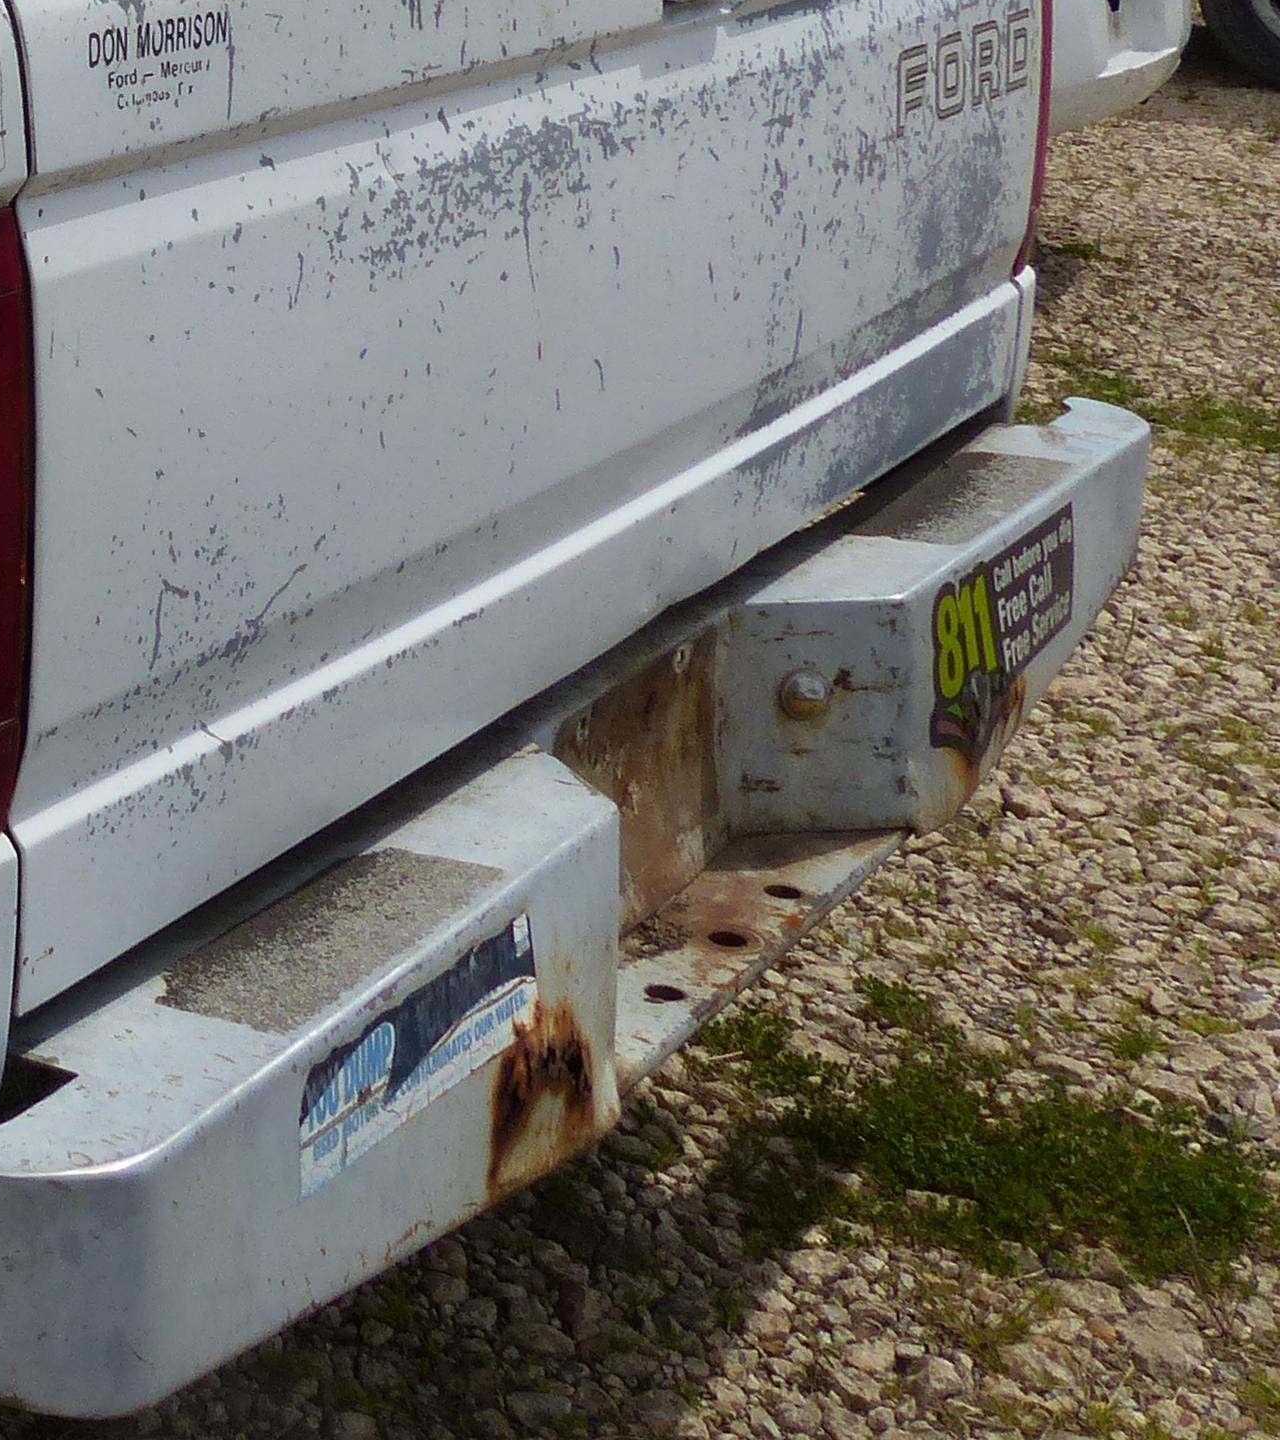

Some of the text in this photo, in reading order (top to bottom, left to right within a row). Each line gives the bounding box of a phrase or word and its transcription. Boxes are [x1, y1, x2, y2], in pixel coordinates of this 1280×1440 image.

[89, 11, 229, 69] DON MORRISON
[896, 7, 1029, 138] FORD
[108, 68, 138, 89] Ford
[993, 558, 1013, 592] Call
[1011, 542, 1042, 579] before
[1040, 528, 1058, 562] you
[998, 562, 1053, 633] Free Call
[937, 574, 998, 699] 811
[1002, 590, 1071, 673] Free Service
[473, 1012, 495, 1041] OUR
